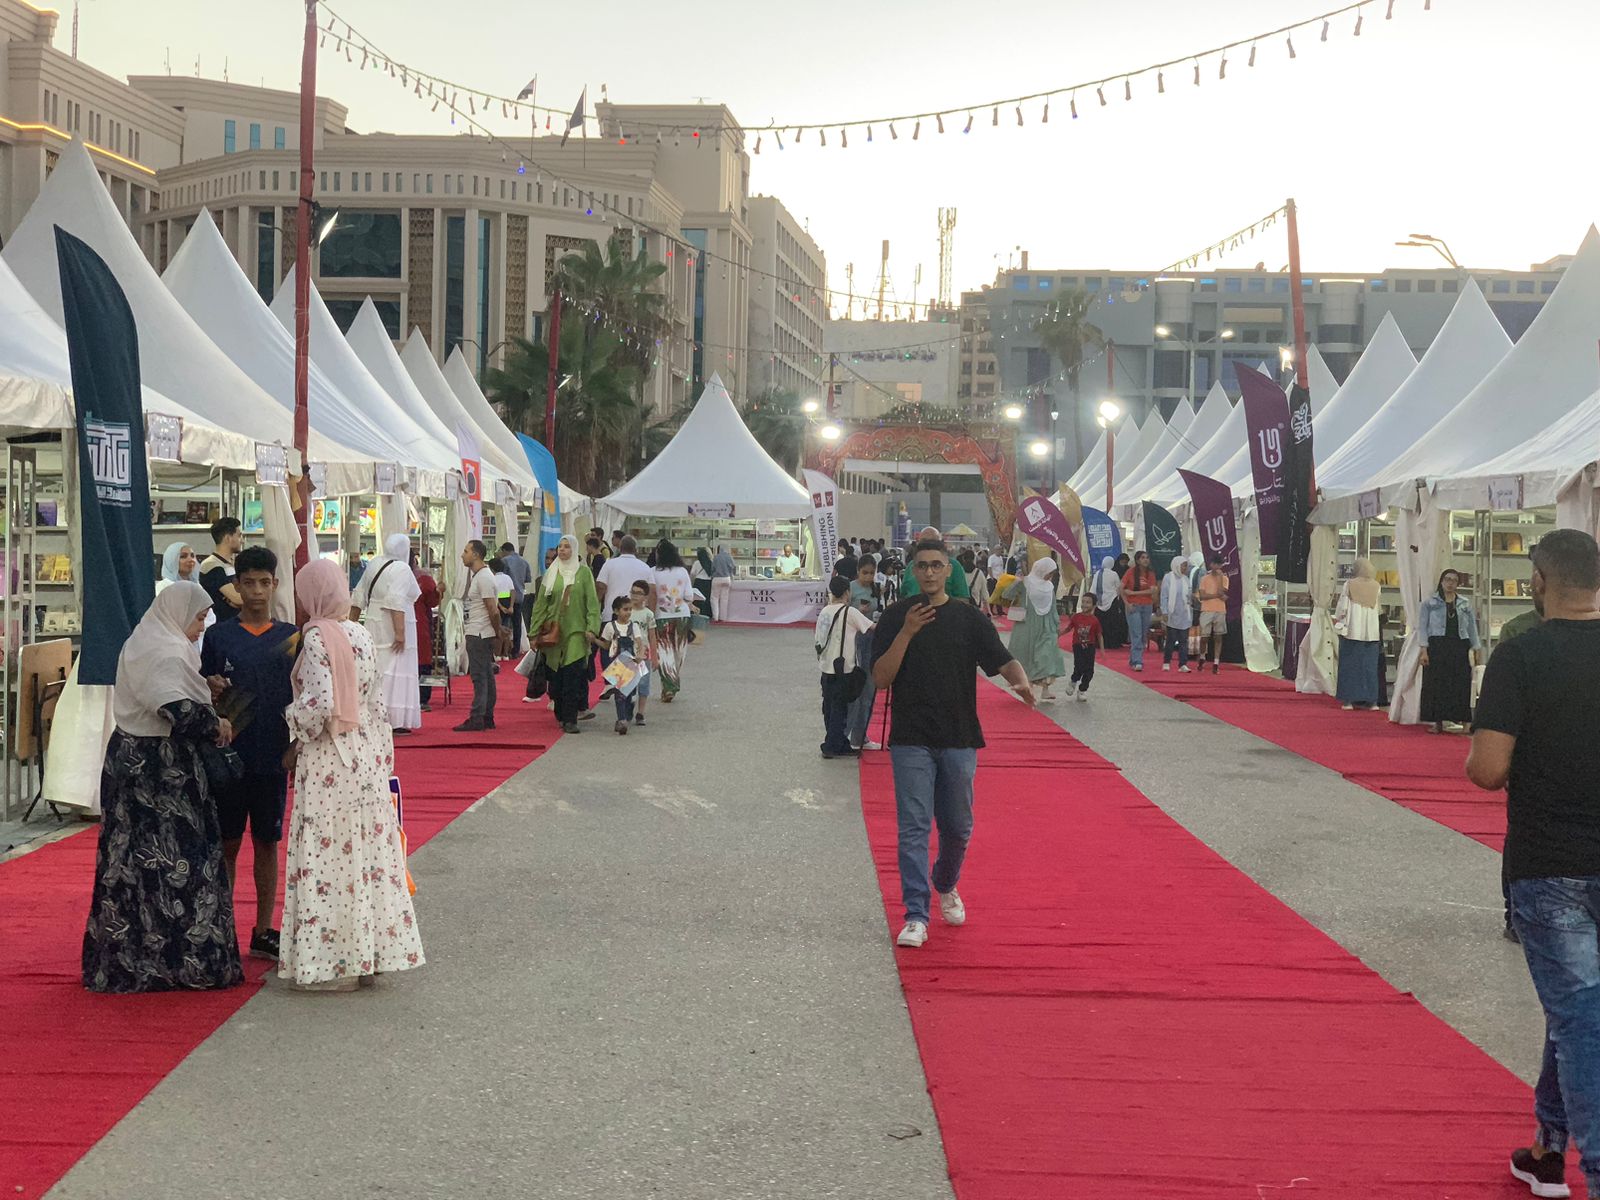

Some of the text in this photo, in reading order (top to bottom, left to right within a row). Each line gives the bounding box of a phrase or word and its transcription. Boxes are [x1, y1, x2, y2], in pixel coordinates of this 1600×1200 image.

[818, 518, 831, 574] PUBLISHING
[826, 512, 837, 566] TRIBUTION
[750, 590, 776, 602] MK
